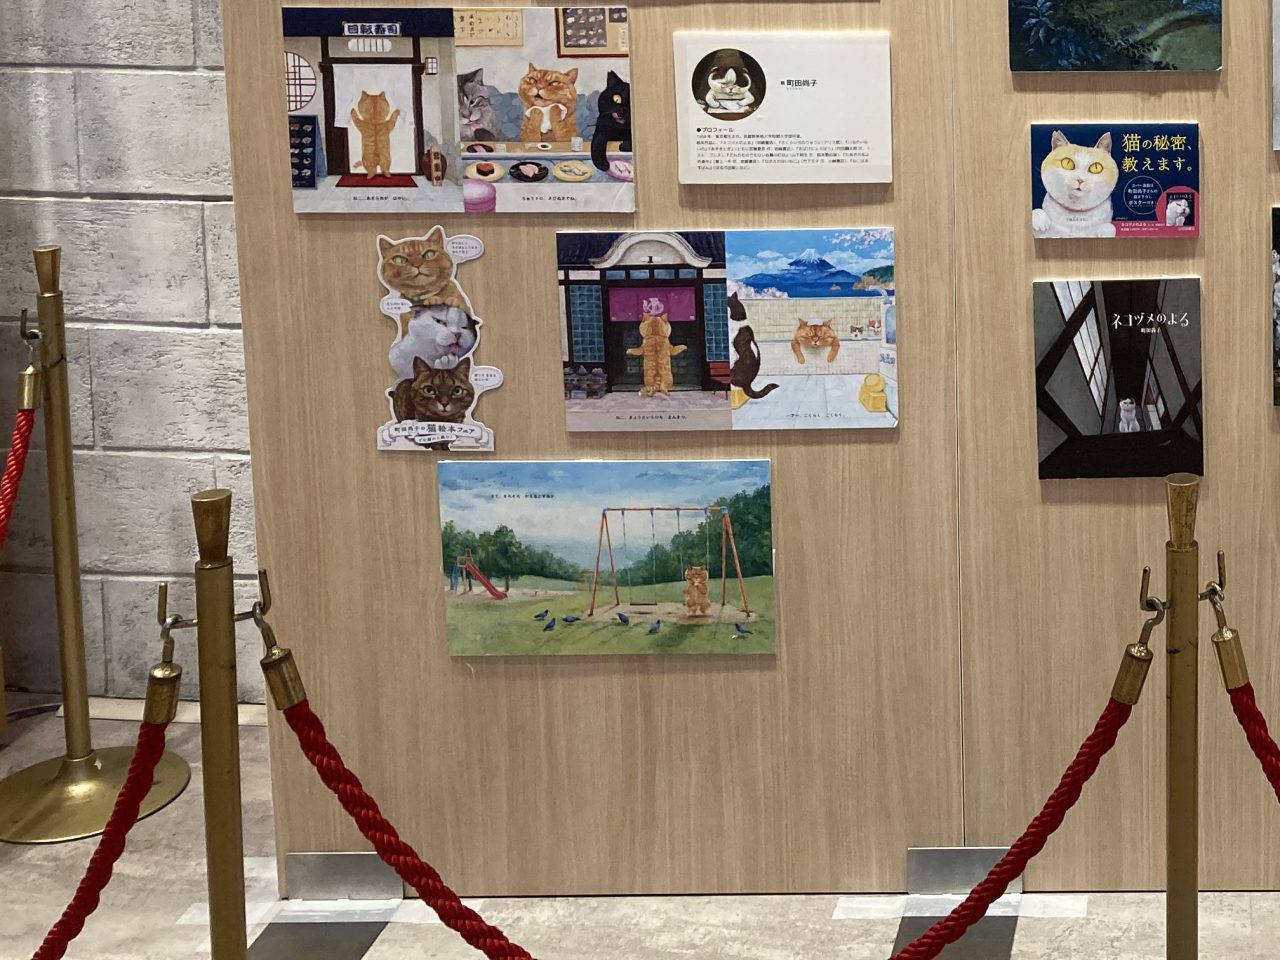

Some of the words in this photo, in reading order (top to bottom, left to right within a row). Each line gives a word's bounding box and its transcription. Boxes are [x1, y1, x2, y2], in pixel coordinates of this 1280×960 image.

[348, 24, 398, 35] 回転寿司
[786, 79, 818, 87] 町田尚子
[1122, 133, 1192, 152] 猫の秘密、
[1122, 157, 1193, 172] 教えます。
[1112, 311, 1190, 329] ネコヅメのよる
